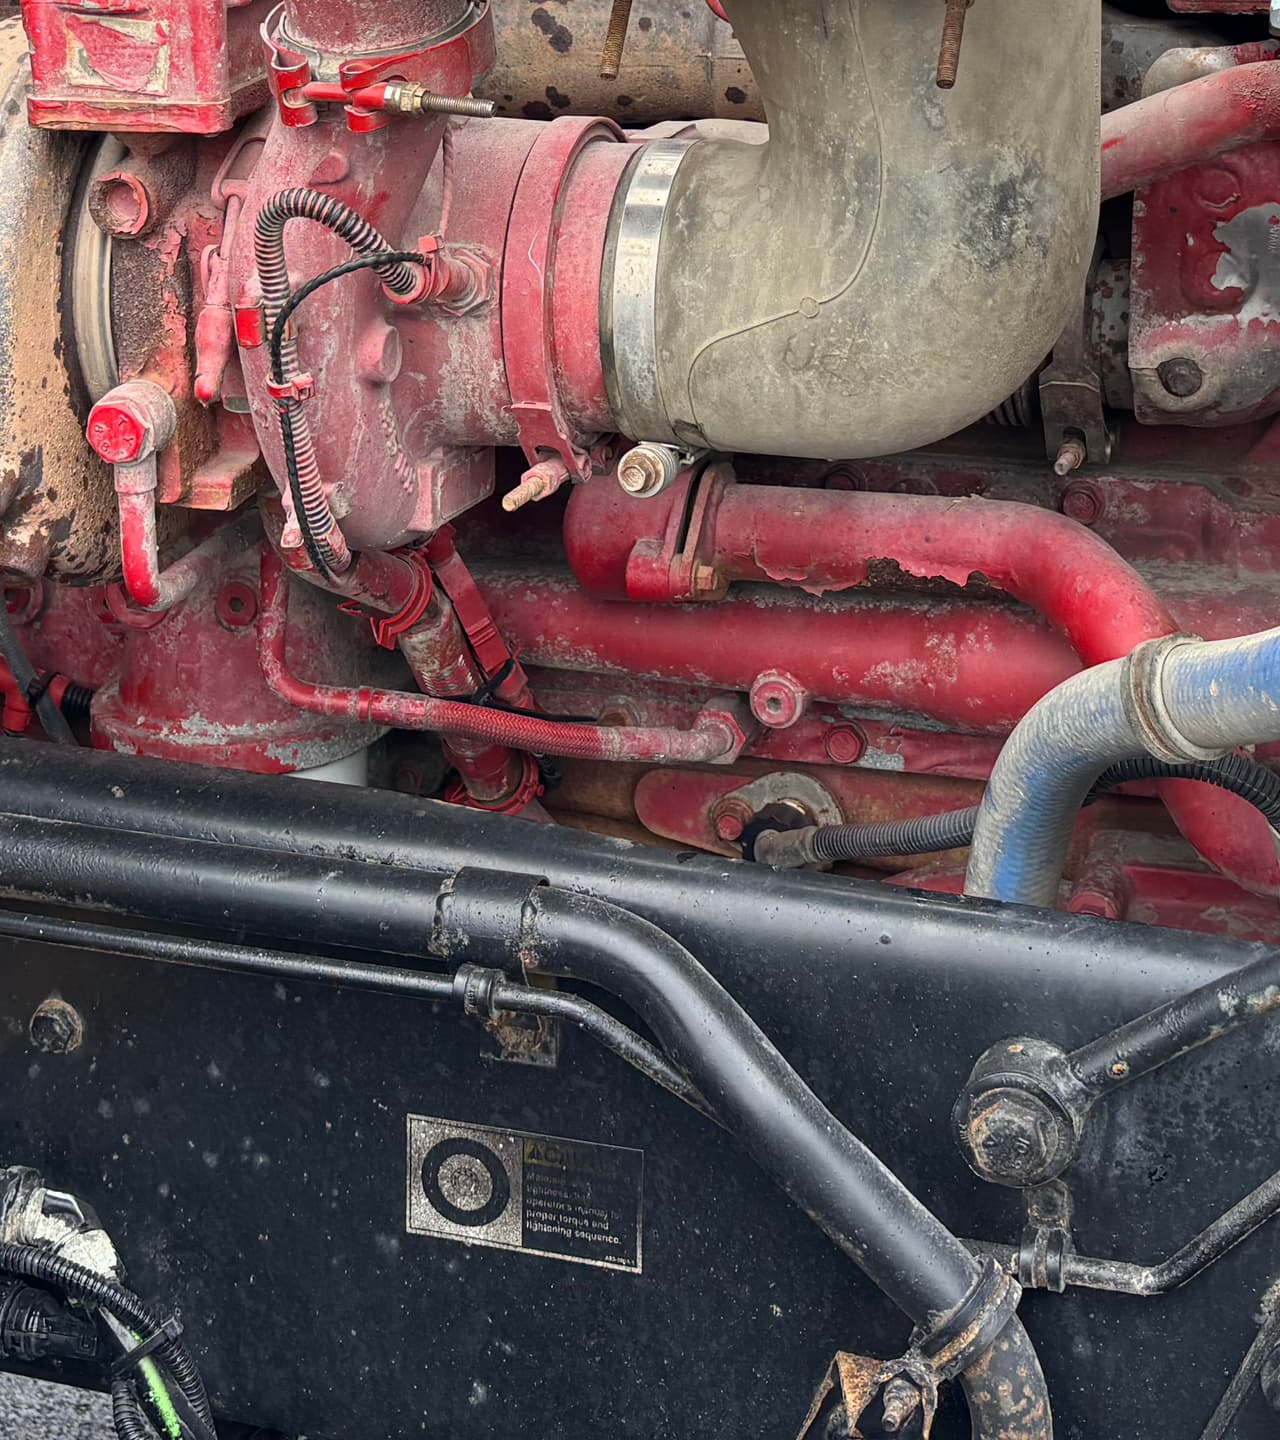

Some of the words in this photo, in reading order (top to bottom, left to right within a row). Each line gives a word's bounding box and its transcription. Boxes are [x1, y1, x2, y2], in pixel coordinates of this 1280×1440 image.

[526, 1208, 557, 1221] proper
[559, 1213, 589, 1228] torque
[591, 1219, 609, 1231] and
[526, 1220, 572, 1238] tightening
[574, 1229, 622, 1245] sequence.
